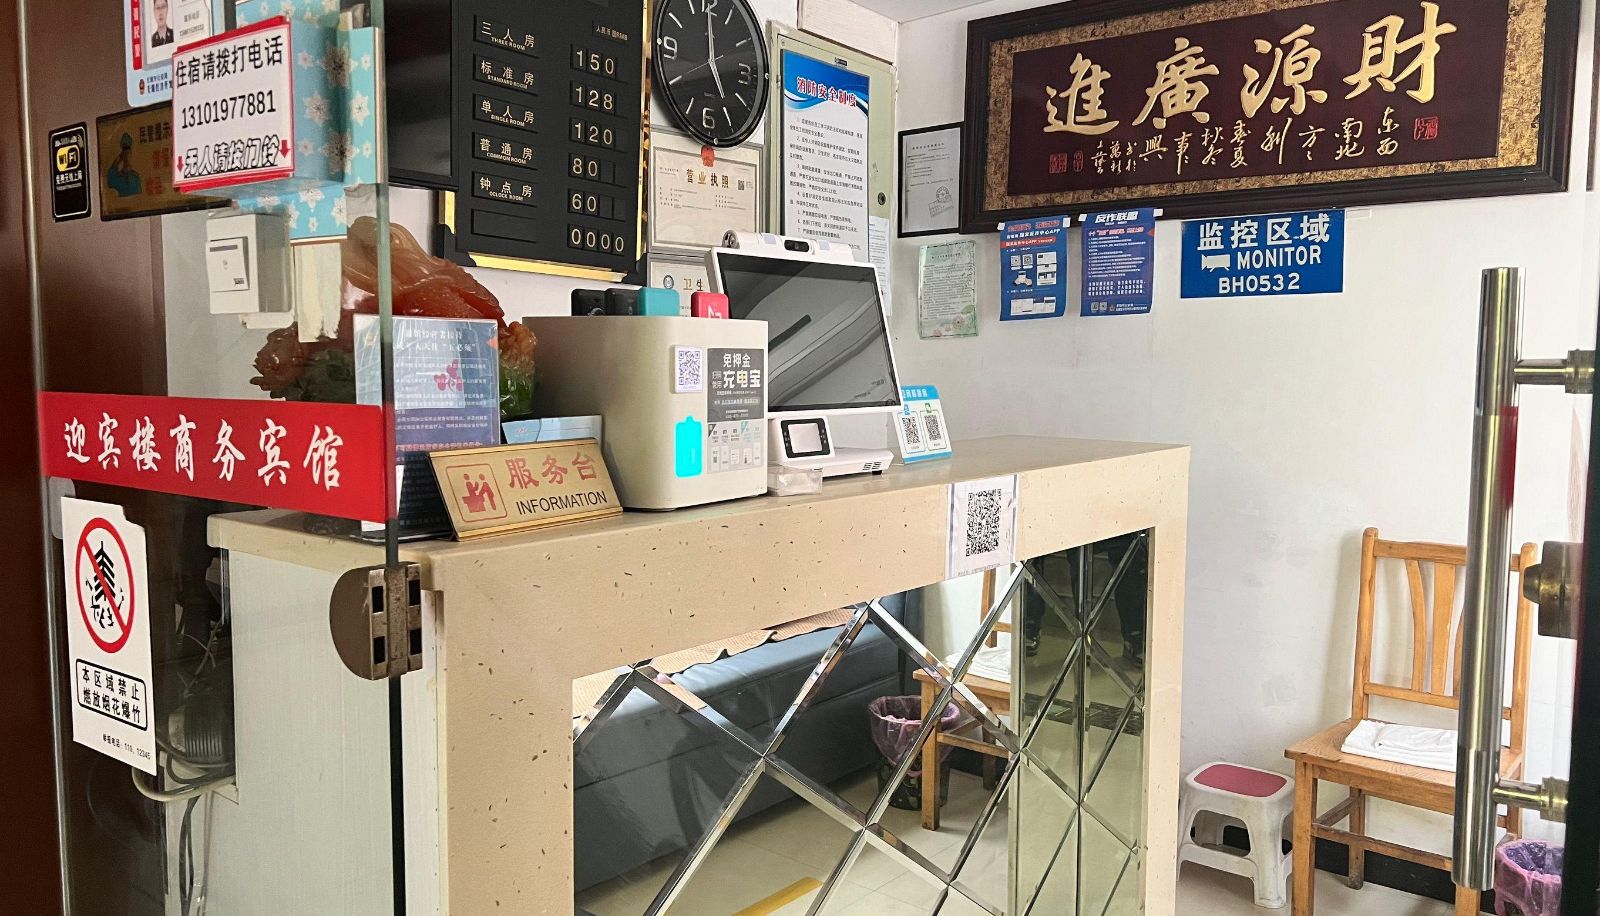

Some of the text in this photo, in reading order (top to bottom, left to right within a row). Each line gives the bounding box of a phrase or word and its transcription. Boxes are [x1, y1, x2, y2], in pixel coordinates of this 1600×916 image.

[481, 21, 535, 48] 三人房
[491, 36, 525, 51] THREE ROOM
[664, 36, 678, 60] 9
[175, 35, 283, 88] 住宿请拨打电话
[480, 60, 534, 86] 标准房
[576, 49, 615, 75] 150
[738, 63, 751, 84] 3
[487, 74, 528, 90] STANDARD ROOM
[797, 77, 857, 108] 消防安全制度
[181, 90, 276, 129] 13101977881
[575, 86, 613, 111] 128
[481, 99, 534, 124] 单人房
[491, 114, 525, 127] SINGLE ROOM
[702, 107, 715, 129] 6
[574, 122, 613, 145] 120
[184, 134, 281, 178] 无人请按门铃
[480, 137, 533, 160] 普通房
[486, 152, 527, 165] COMMON ROOM
[572, 157, 598, 177] 80
[686, 168, 729, 188] 营业执照
[479, 177, 532, 198] 钟点房
[508, 193, 524, 201] ROOM
[571, 193, 597, 212] 60
[571, 228, 625, 252] 0000
[1197, 212, 1330, 251] 监控区域
[1237, 245, 1322, 270] MONITOR
[723, 352, 751, 368] 免押金
[723, 369, 761, 388] 充电宝
[63, 411, 344, 492] 迎宾楼商务宾馆
[505, 451, 597, 490] 服务台
[515, 489, 608, 516] INFORMATION
[82, 665, 141, 701] 本区域禁止
[83, 686, 141, 724] 燃放烟花爆竹
